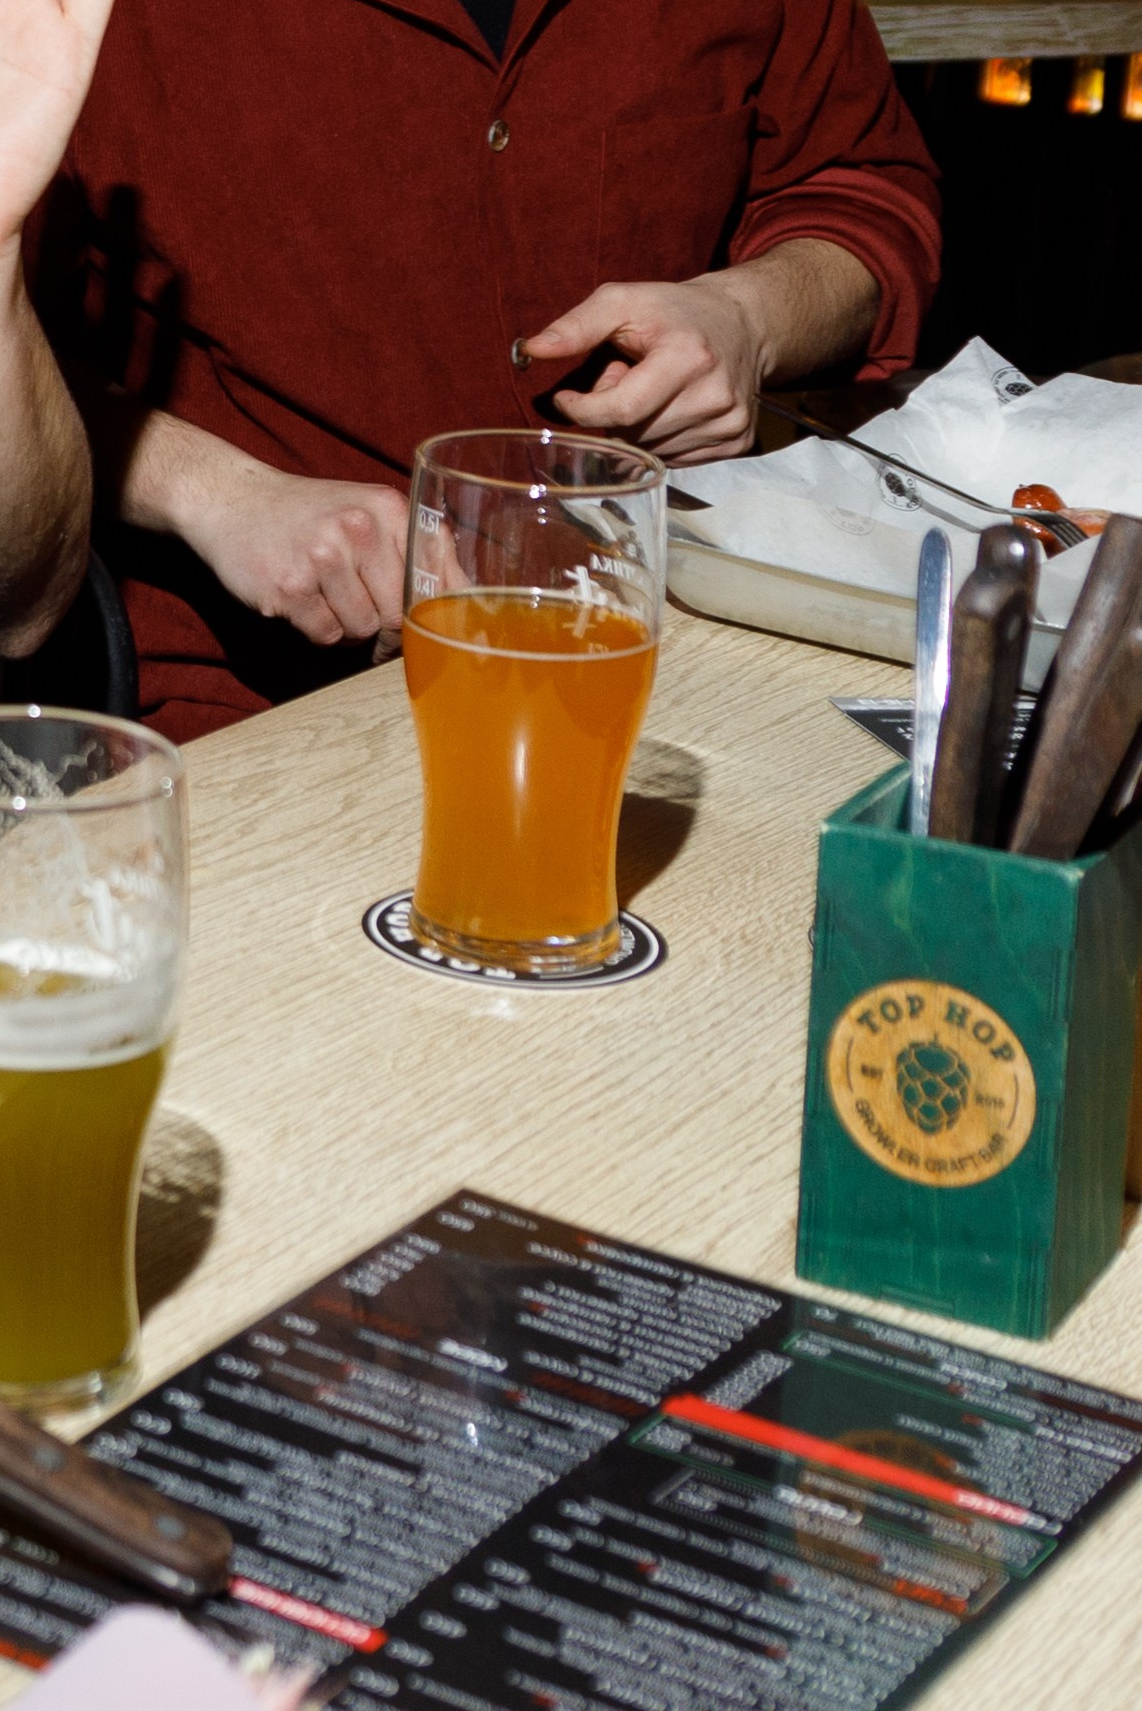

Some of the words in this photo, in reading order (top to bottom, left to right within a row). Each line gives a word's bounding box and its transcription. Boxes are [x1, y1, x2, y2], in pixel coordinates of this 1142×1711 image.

[856, 994, 925, 1034] TOP
[944, 1000, 1016, 1062] HOP
[924, 1153, 979, 1174] CRAFT
[978, 1131, 1005, 1164] BAR
